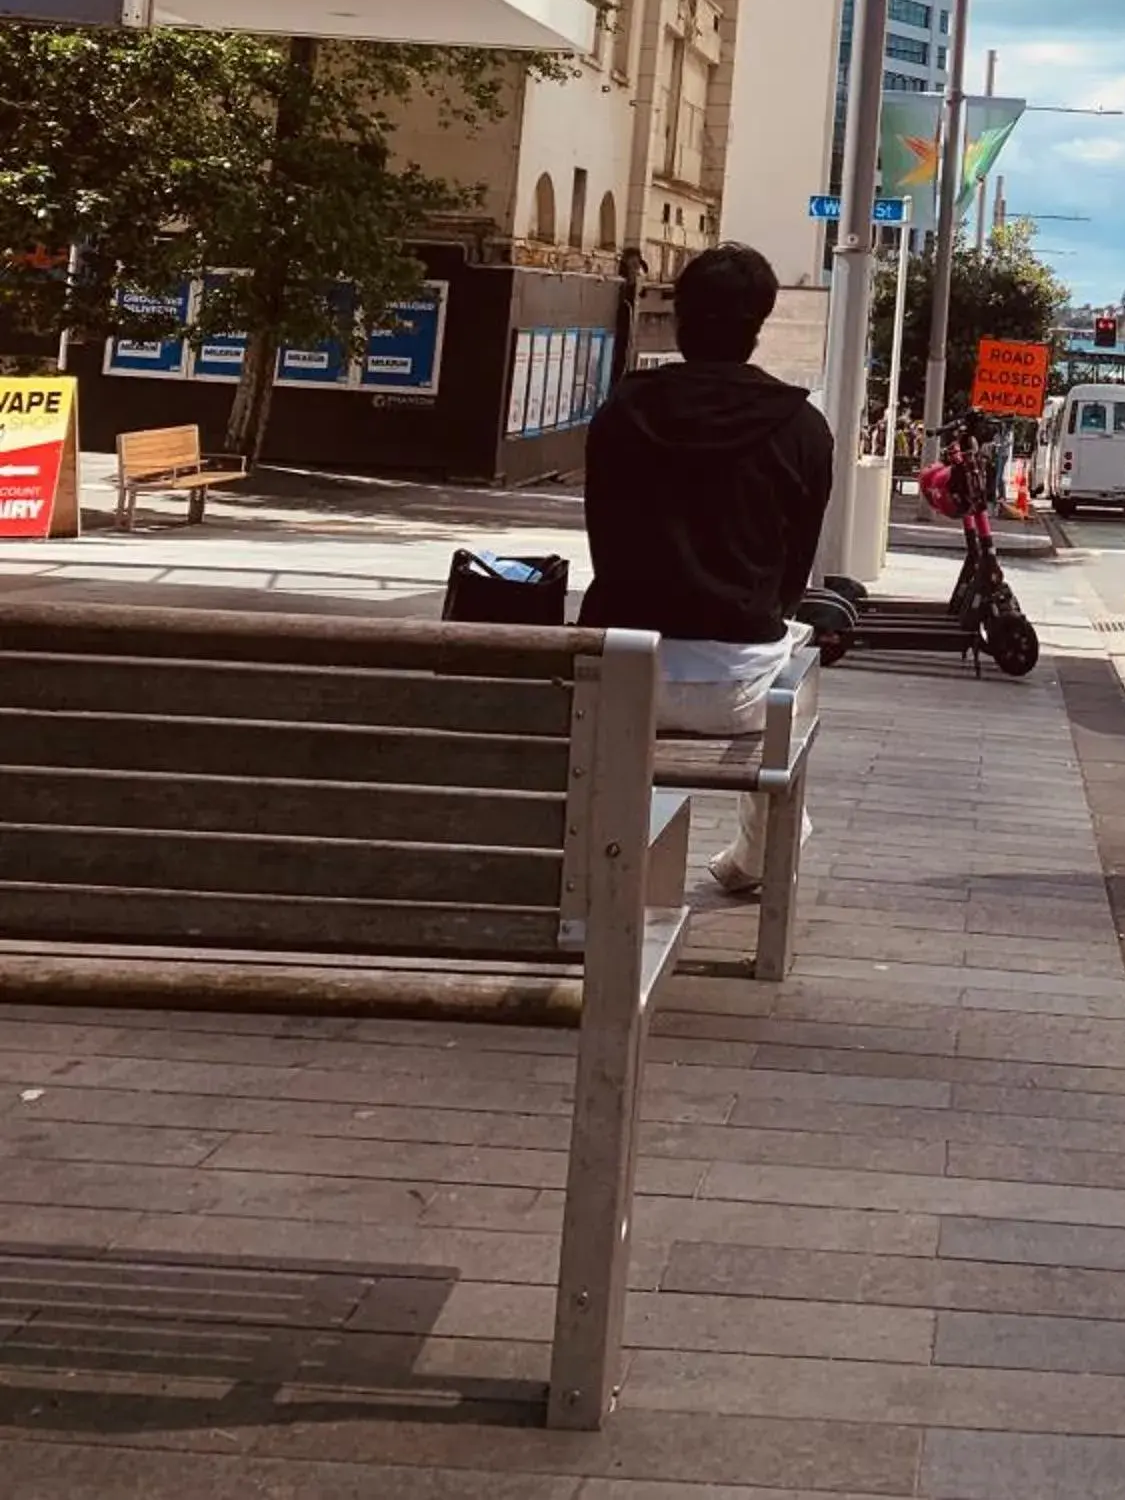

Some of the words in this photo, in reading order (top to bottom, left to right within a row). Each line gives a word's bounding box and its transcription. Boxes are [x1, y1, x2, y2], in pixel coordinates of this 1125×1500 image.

[875, 201, 892, 218] St
[990, 348, 1035, 366] ROAD
[978, 368, 1041, 388] CLOSED
[978, 390, 1037, 409] AHEAD
